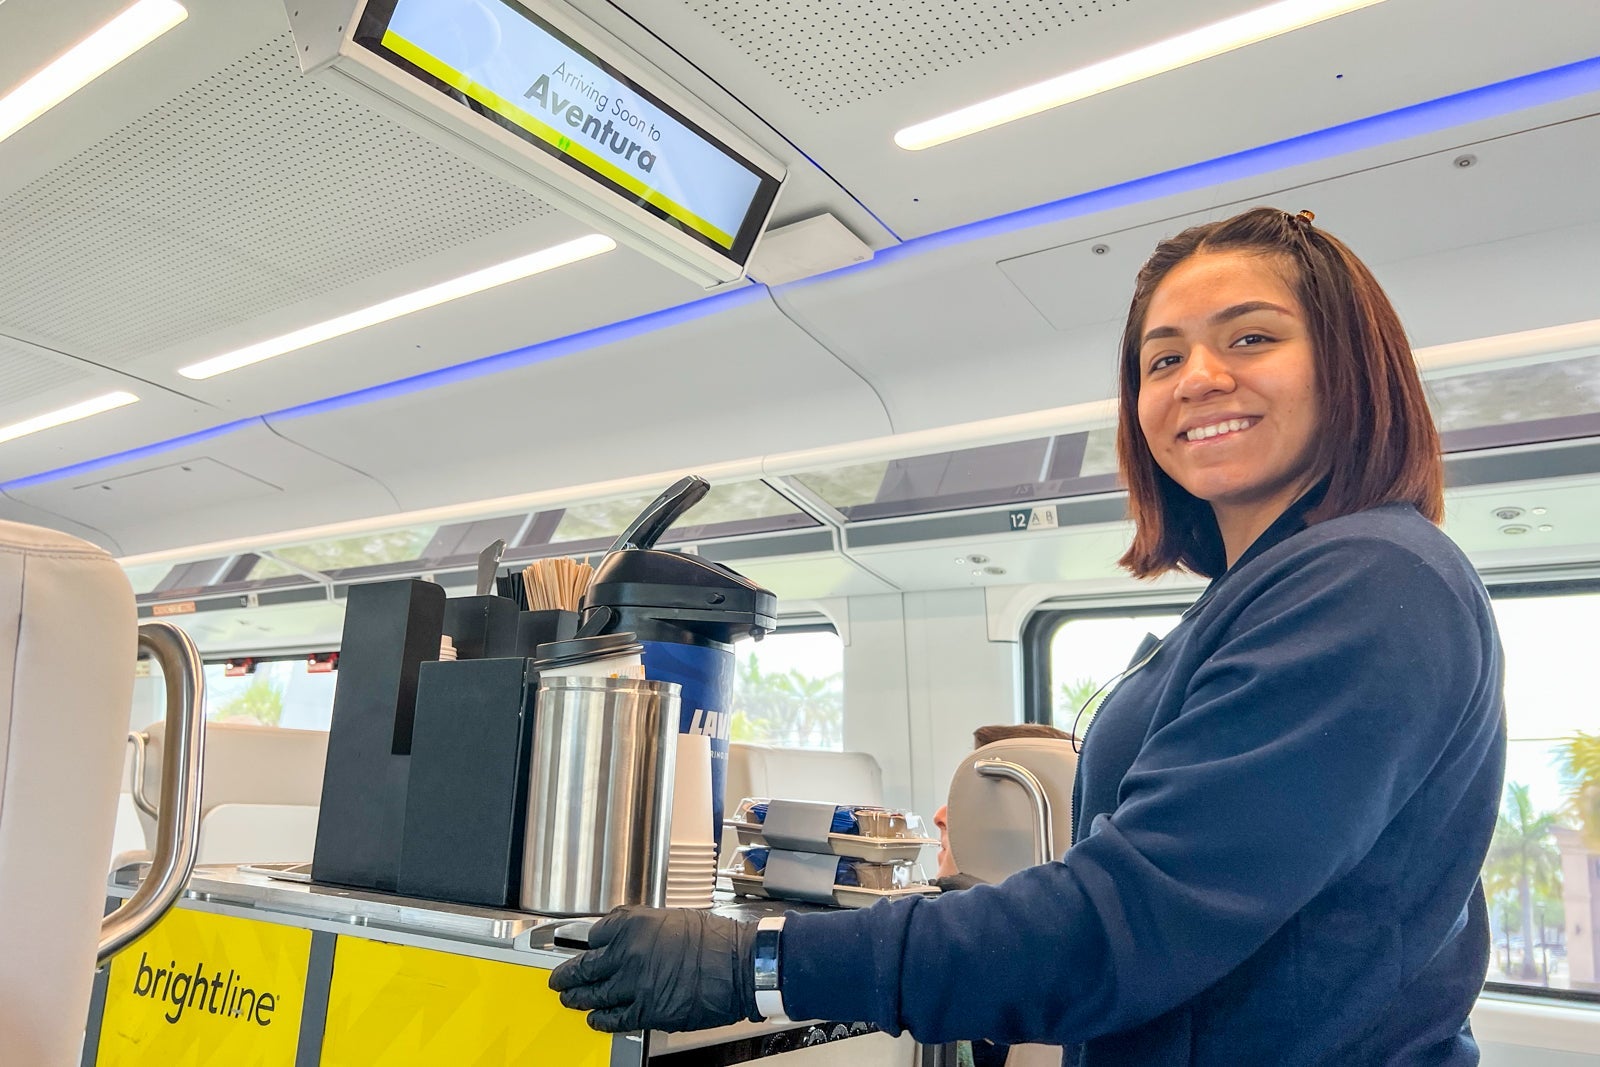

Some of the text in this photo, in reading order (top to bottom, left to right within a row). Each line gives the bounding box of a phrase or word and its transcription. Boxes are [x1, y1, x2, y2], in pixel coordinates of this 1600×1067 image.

[523, 73, 657, 173] Aventura
[552, 61, 661, 142] Arriving Soon to
[1010, 511, 1053, 528] 12 A B
[688, 709, 730, 741] LAV
[133, 952, 276, 1026] brightline
